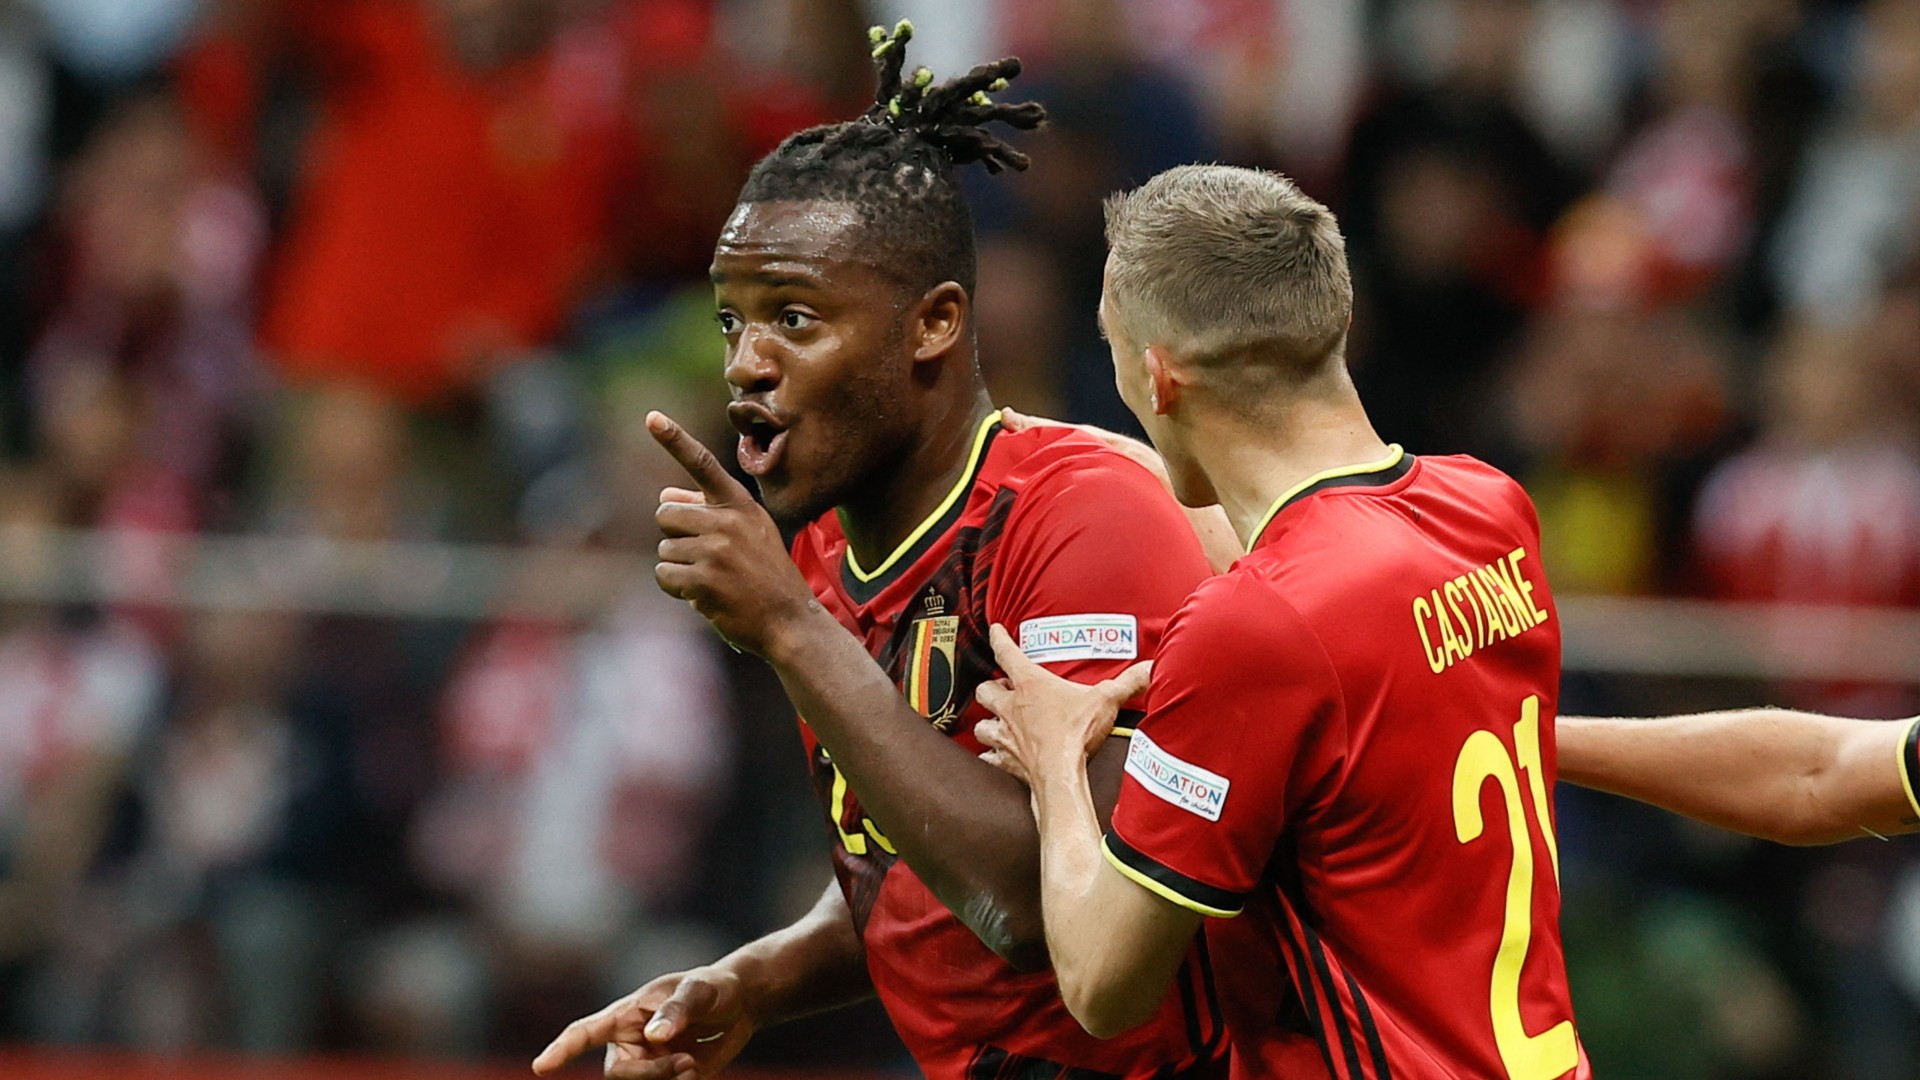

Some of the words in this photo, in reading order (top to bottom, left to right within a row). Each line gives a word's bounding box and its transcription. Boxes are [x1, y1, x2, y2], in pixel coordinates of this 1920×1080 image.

[1021, 628, 1132, 648] FOUNDATION
[1412, 546, 1548, 674] CASTAGNE
[1131, 743, 1222, 806] FOUNDATION
[1191, 801, 1216, 816] children
[1452, 695, 1579, 1080] 21
